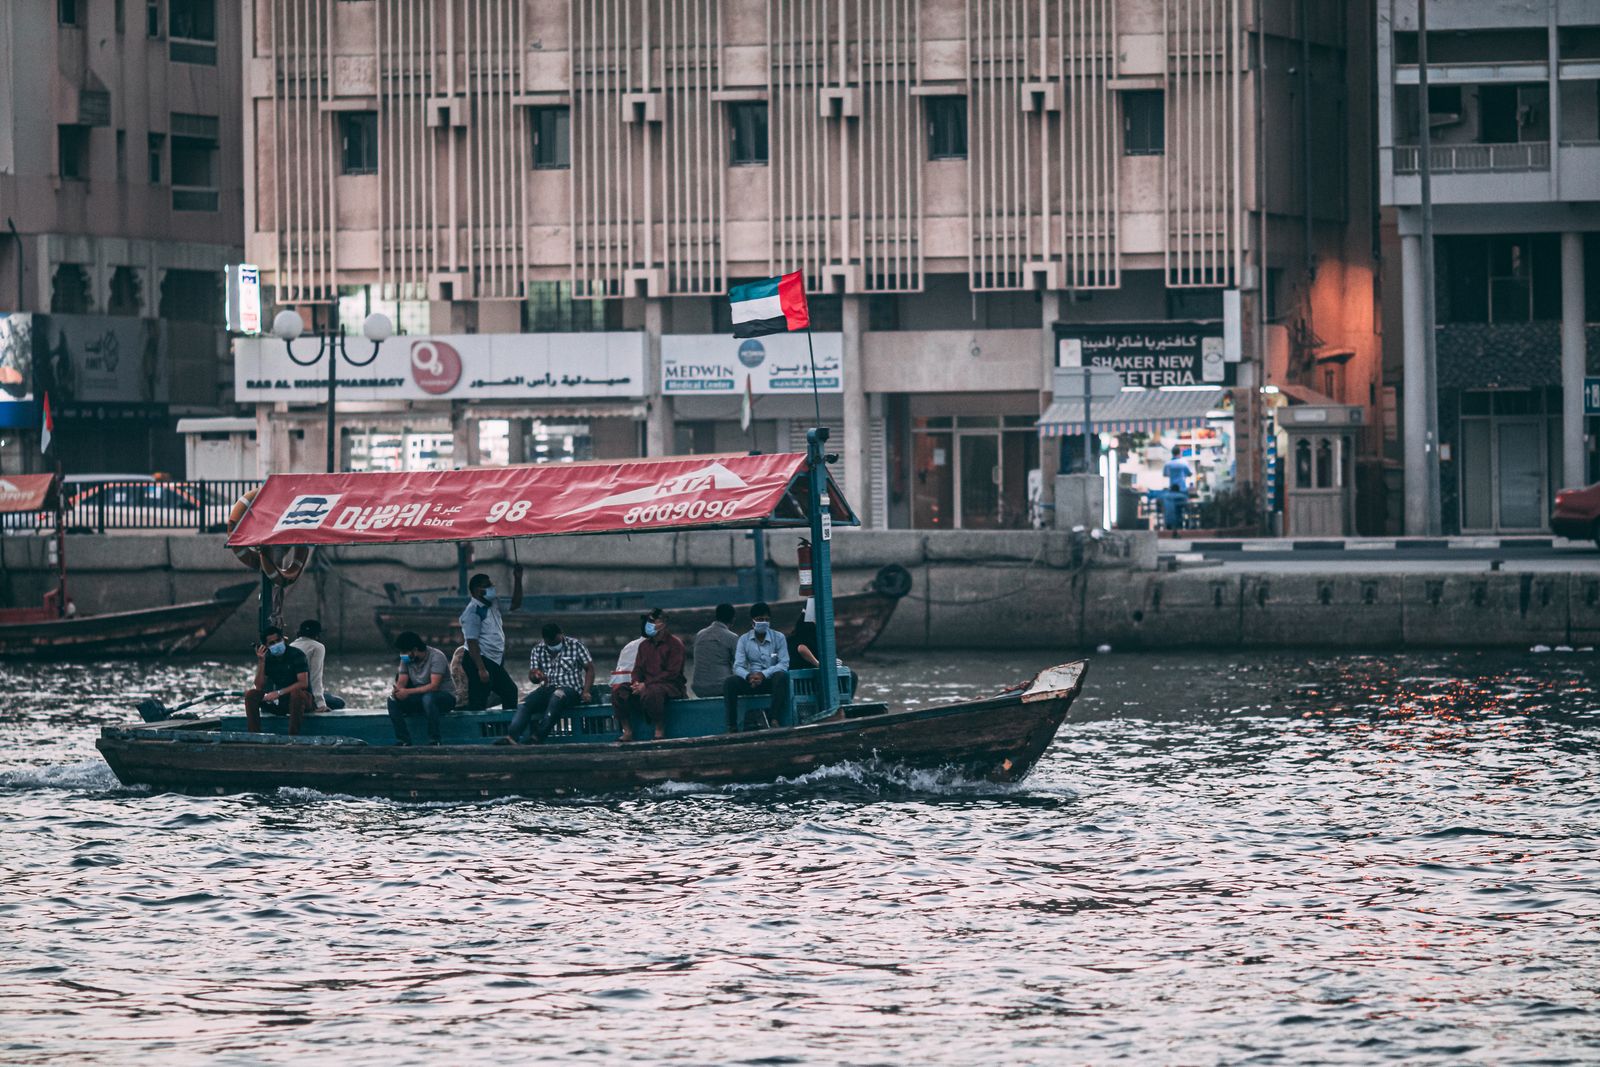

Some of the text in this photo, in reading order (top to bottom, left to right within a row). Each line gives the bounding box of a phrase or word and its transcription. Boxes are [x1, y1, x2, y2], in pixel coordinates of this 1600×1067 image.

[1115, 335, 1143, 350] شاكر
[1145, 336, 1197, 350] كافتيريا
[1092, 356, 1194, 368] SHAKER NEW
[665, 365, 734, 378] MEDWIN
[1117, 370, 1196, 386] FETERIA
[275, 379, 291, 389] AL
[527, 372, 557, 388] رأس
[561, 375, 631, 387] صيدلية
[669, 380, 701, 390] Medical
[655, 474, 717, 495] RTA
[485, 500, 532, 523] 98
[423, 515, 454, 527] abra
